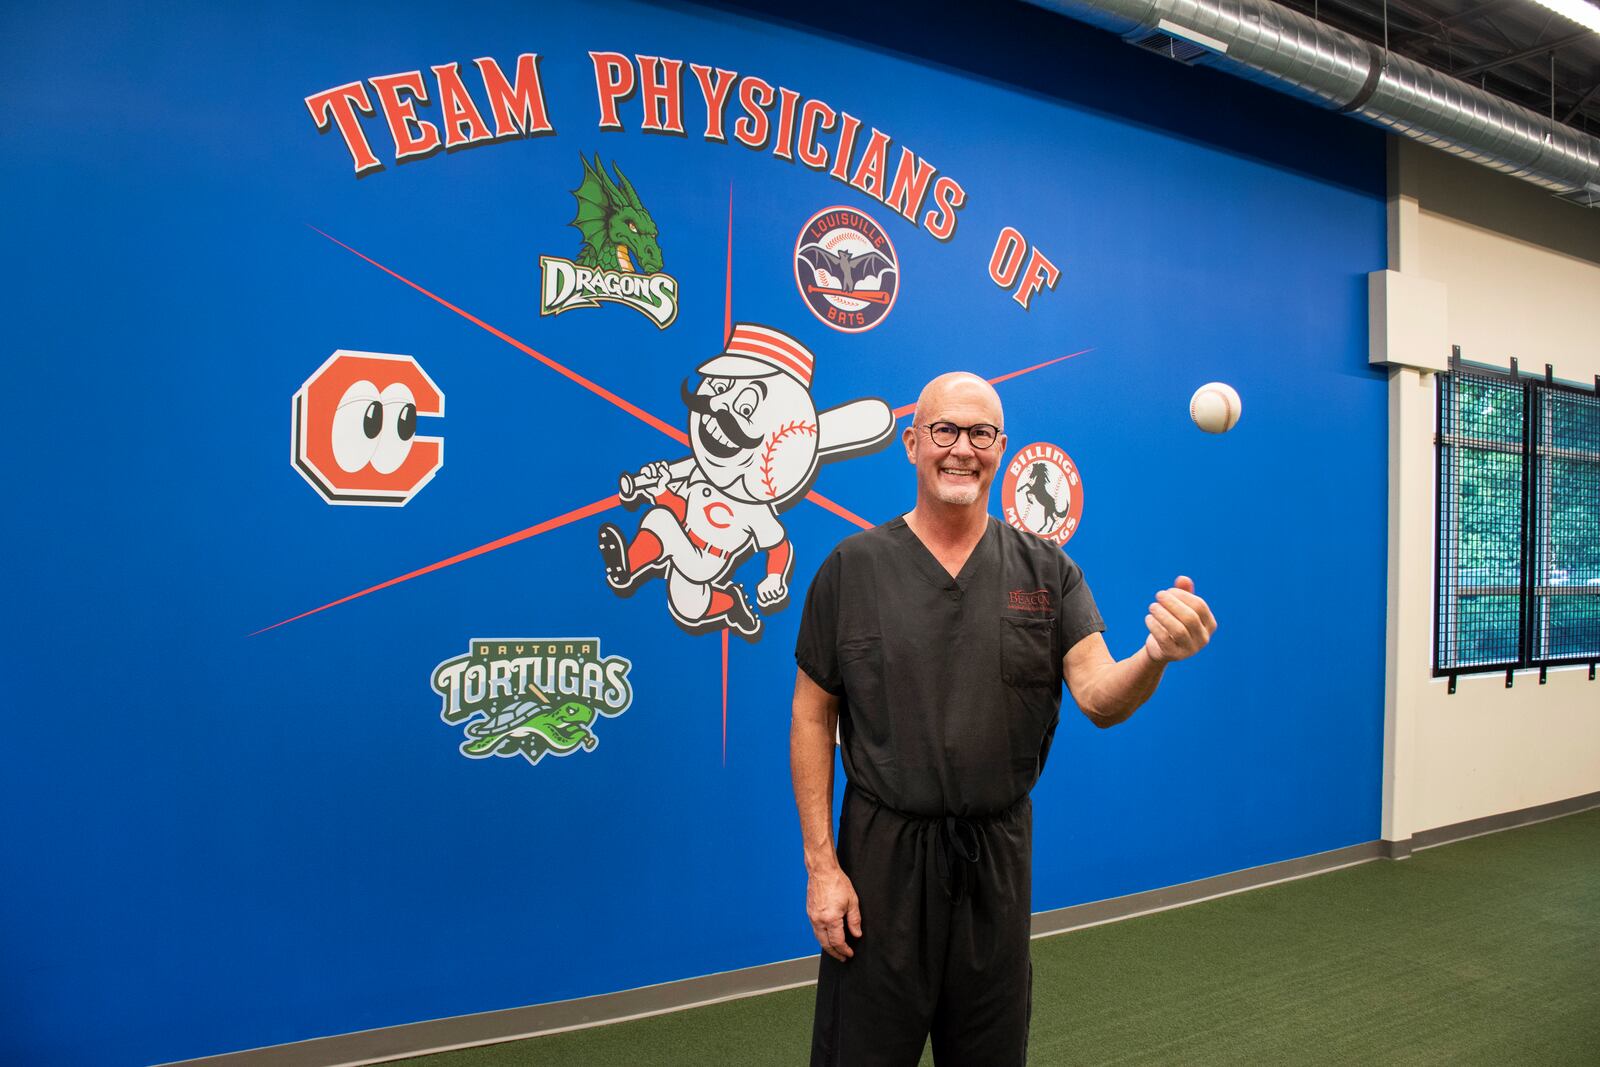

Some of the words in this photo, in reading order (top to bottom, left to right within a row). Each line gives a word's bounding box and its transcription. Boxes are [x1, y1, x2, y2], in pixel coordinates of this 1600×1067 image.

[304, 53, 554, 174] TEAM
[588, 51, 967, 240] PHYSICIANS
[988, 226, 1060, 310] OF
[811, 213, 885, 248] LOUISVILLE
[541, 257, 675, 325] DRAGONS
[827, 306, 865, 326] BATS
[1010, 446, 1078, 487] BILLINGS
[703, 502, 734, 529] C
[480, 645, 590, 656] DAYTONA
[438, 656, 627, 715] TORTUGAS
